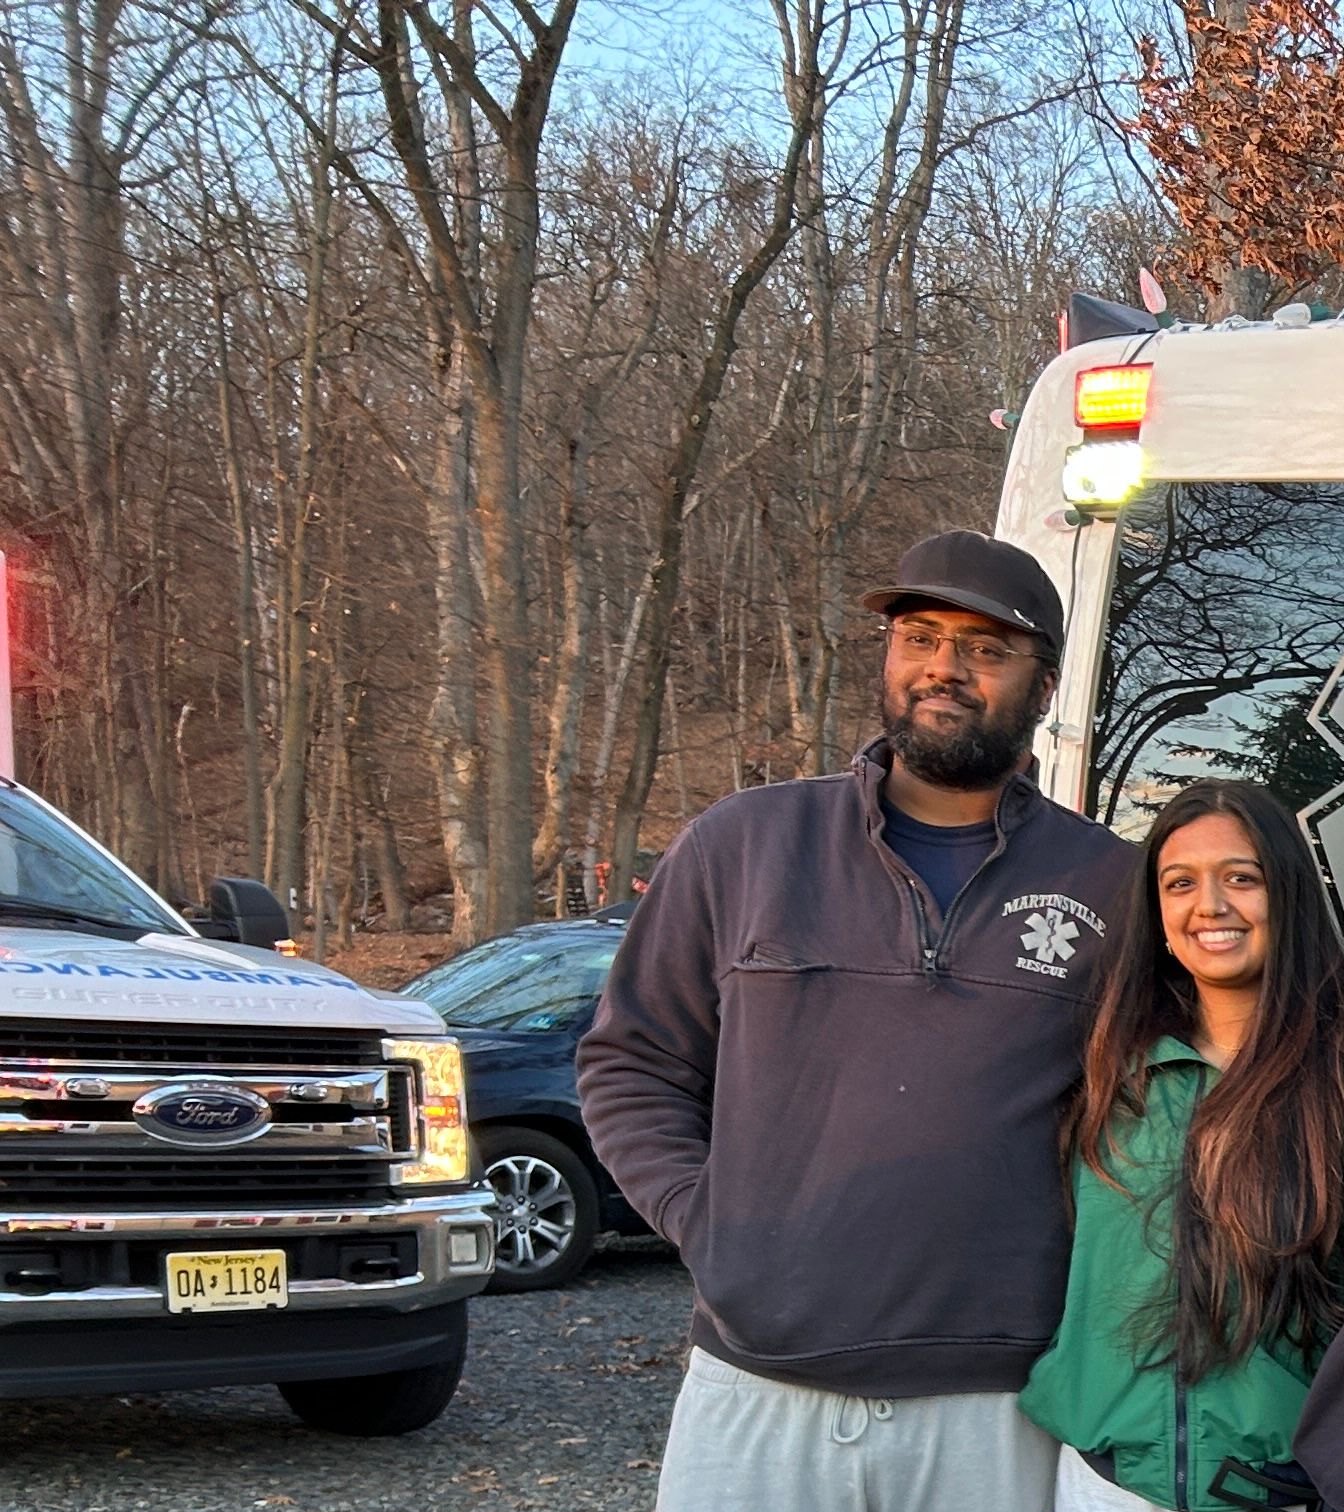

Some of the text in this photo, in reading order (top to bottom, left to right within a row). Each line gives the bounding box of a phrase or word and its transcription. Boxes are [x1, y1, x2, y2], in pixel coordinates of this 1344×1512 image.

[1002, 893, 1107, 938] MARTINSVILLE
[1016, 956, 1068, 979] RESCUE
[176, 1098, 239, 1126] Ford
[197, 1255, 257, 1266] New Jersey
[225, 1266, 281, 1296] 1184
